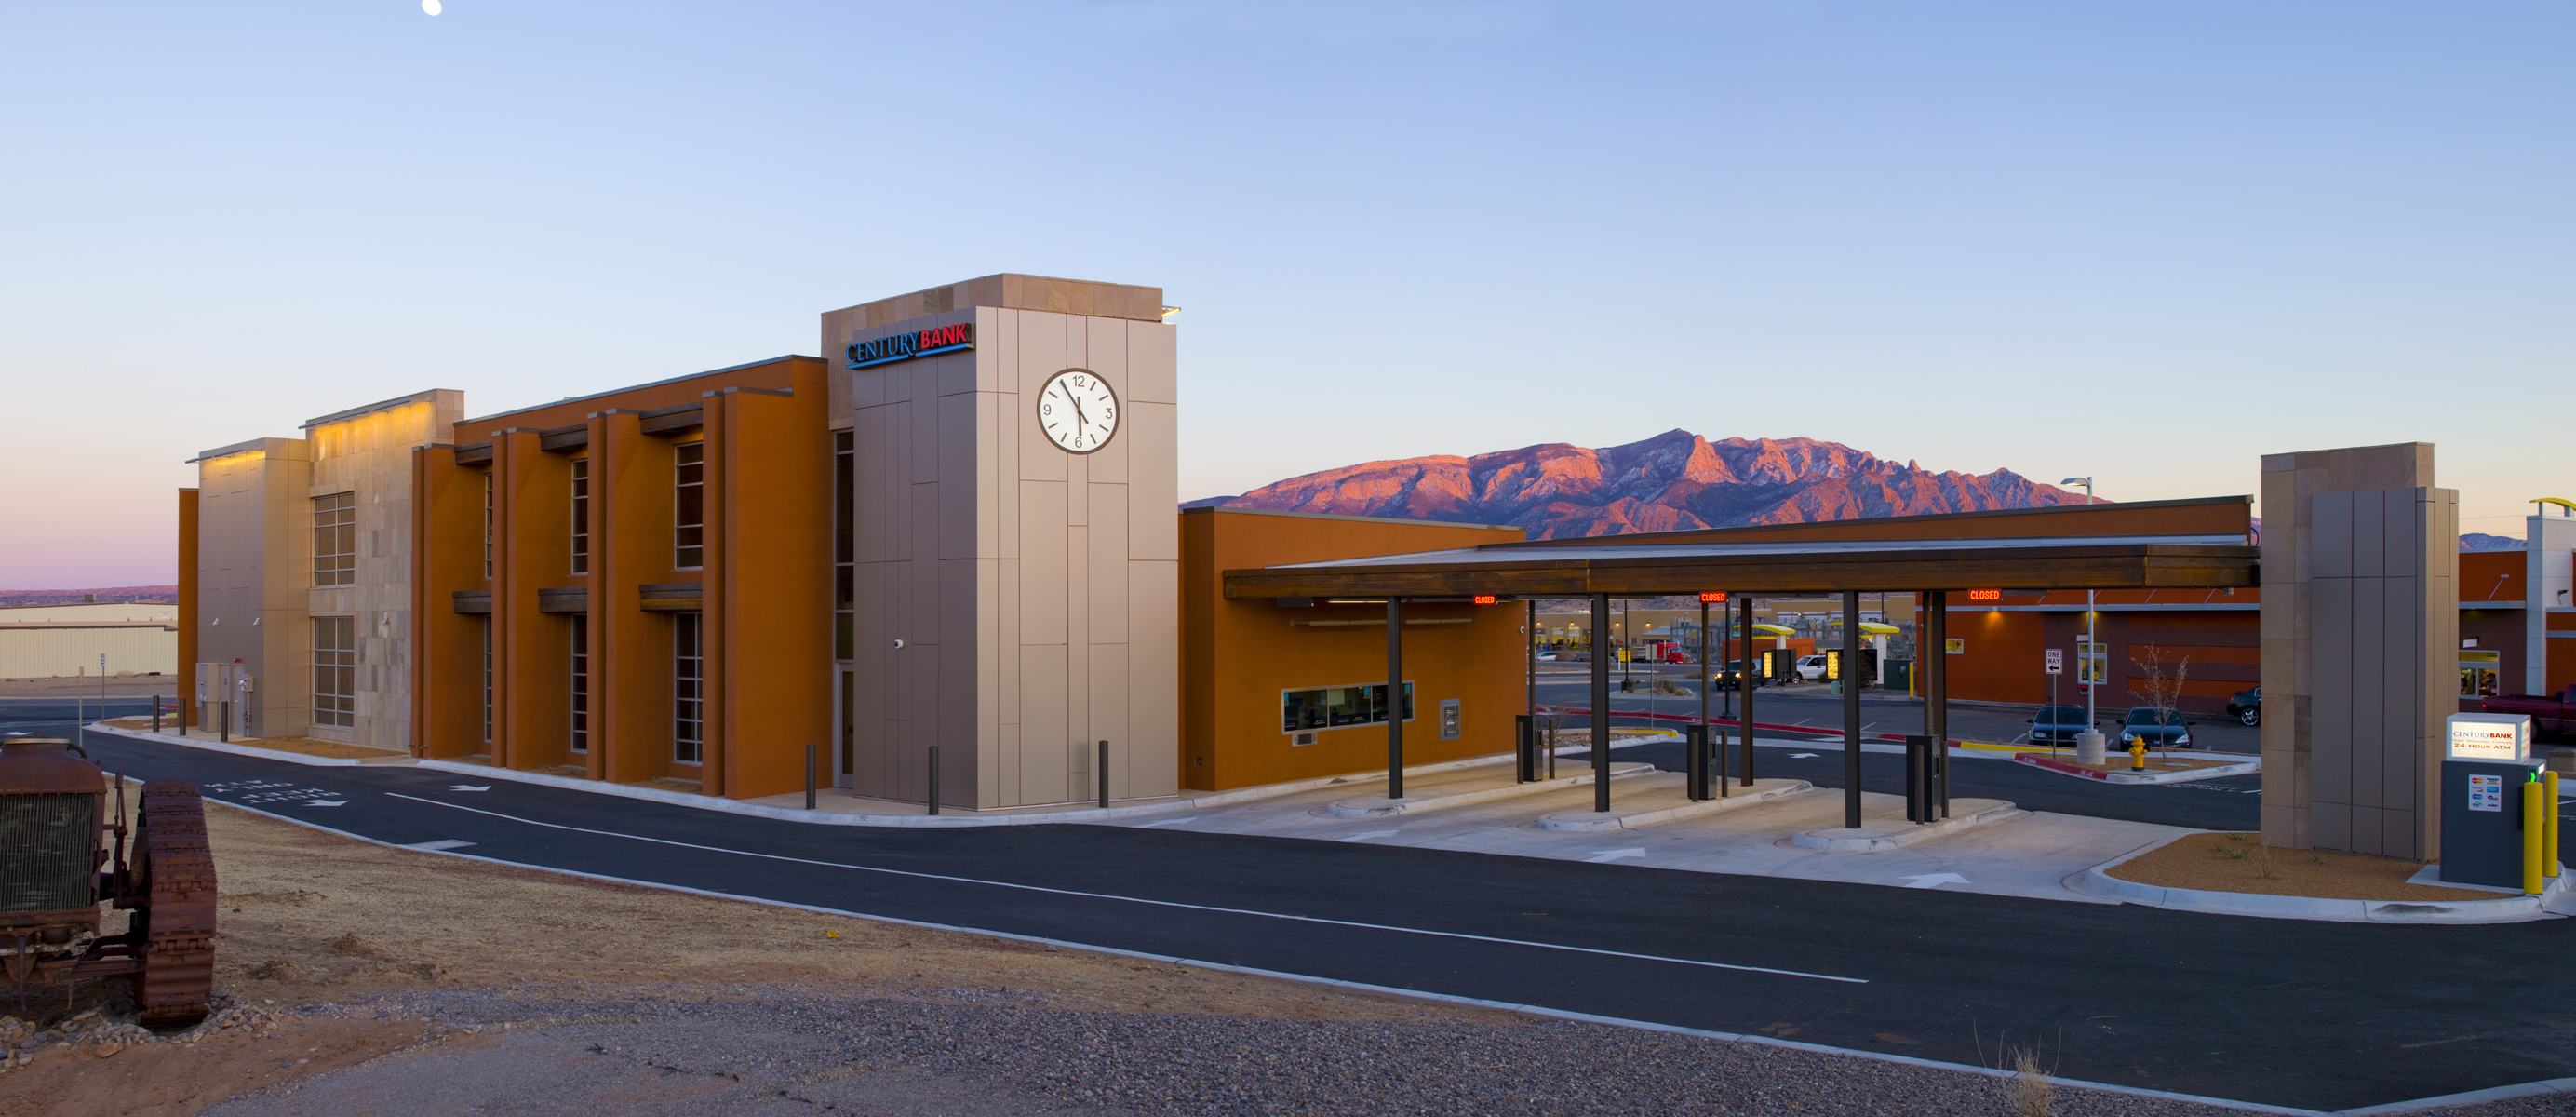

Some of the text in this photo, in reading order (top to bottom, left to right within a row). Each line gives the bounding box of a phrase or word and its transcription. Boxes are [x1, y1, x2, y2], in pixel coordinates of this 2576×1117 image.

[1072, 375, 1085, 387] 12
[1043, 404, 1052, 416] 9
[1105, 407, 1113, 419] 3
[1075, 436, 1082, 448] 6
[1475, 596, 1495, 604] CLOSED
[1701, 593, 1725, 601] CLOSED
[1970, 590, 2000, 600] CLOSED
